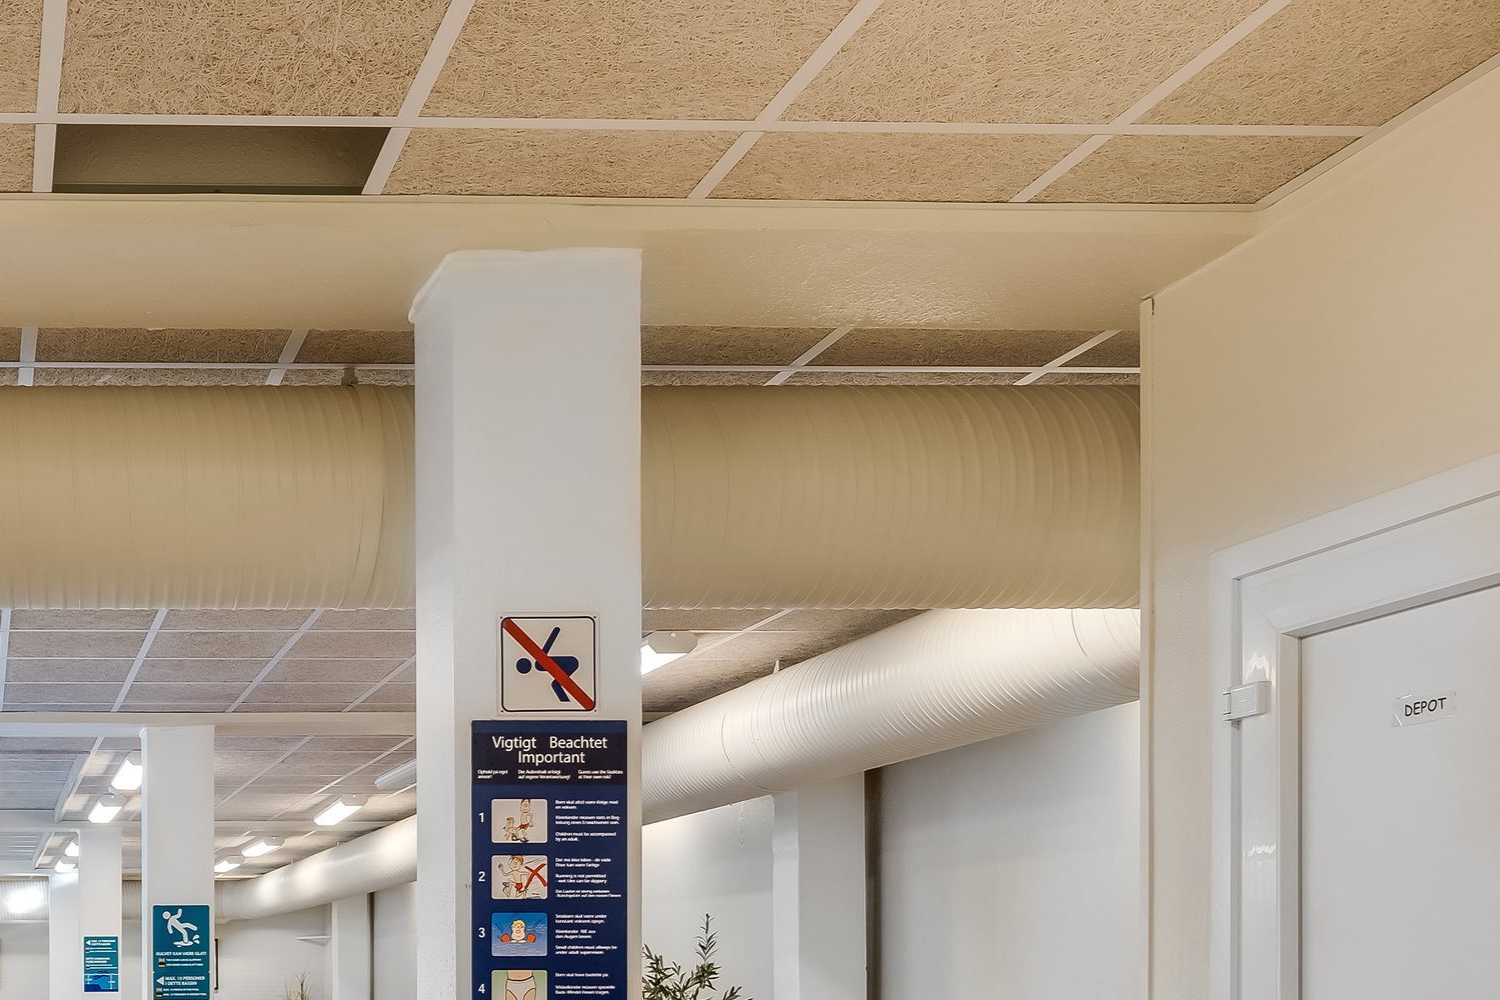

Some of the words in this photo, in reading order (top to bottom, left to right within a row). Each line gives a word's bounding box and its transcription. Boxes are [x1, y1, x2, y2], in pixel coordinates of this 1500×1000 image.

[1404, 697, 1447, 717] DEPOT
[492, 736, 537, 751] Vigtigt
[550, 736, 608, 749] Beachtet
[518, 751, 585, 766] Important
[479, 813, 484, 822] 1
[478, 872, 486, 882] 2
[478, 927, 486, 938] 3
[478, 983, 486, 994] 4
